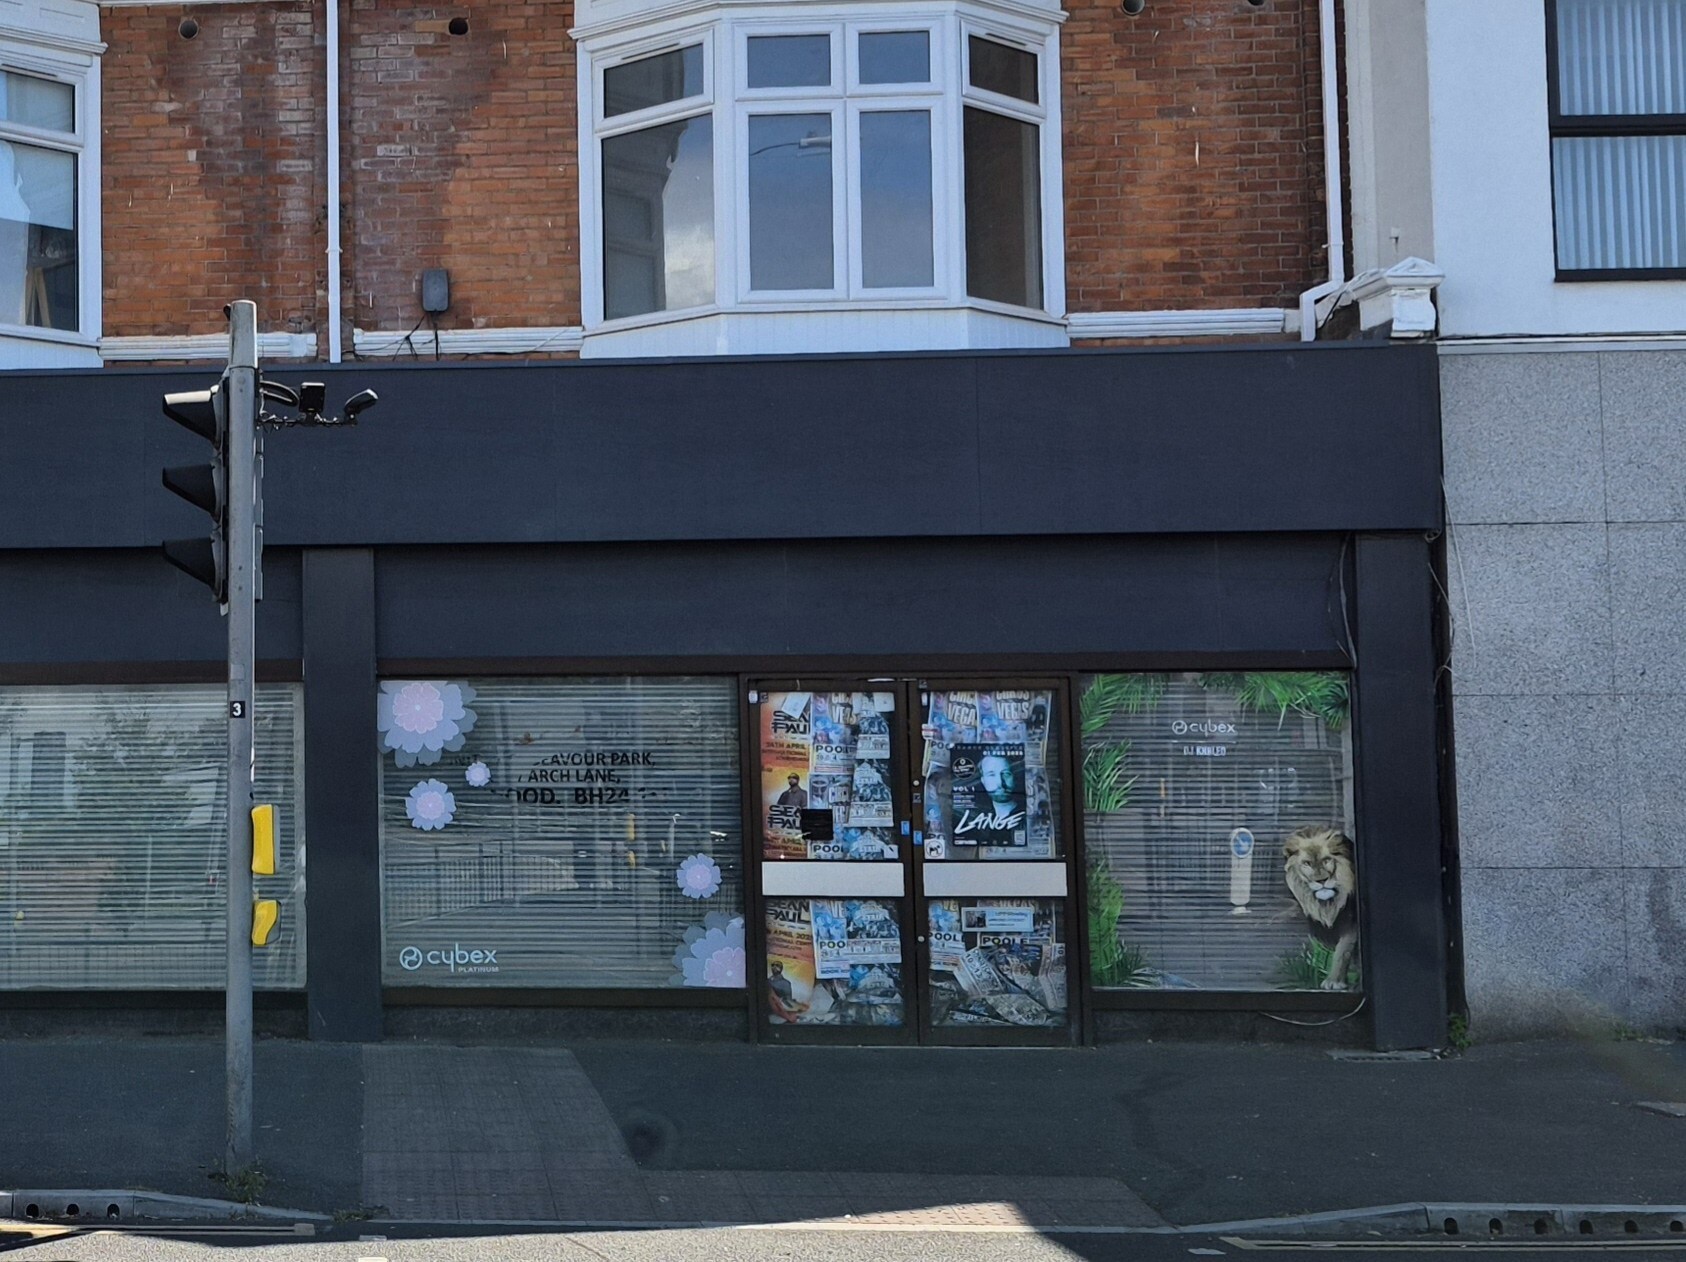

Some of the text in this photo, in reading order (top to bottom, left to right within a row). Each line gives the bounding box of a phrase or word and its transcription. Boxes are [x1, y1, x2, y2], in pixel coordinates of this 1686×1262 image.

[233, 703, 241, 716] 3
[1190, 719, 1235, 737] cybex
[611, 752, 656, 766] PARK,
[528, 769, 570, 783] ARCH
[576, 769, 621, 784] LANE,
[954, 809, 1026, 834] LANGE
[427, 942, 497, 973] cybex
